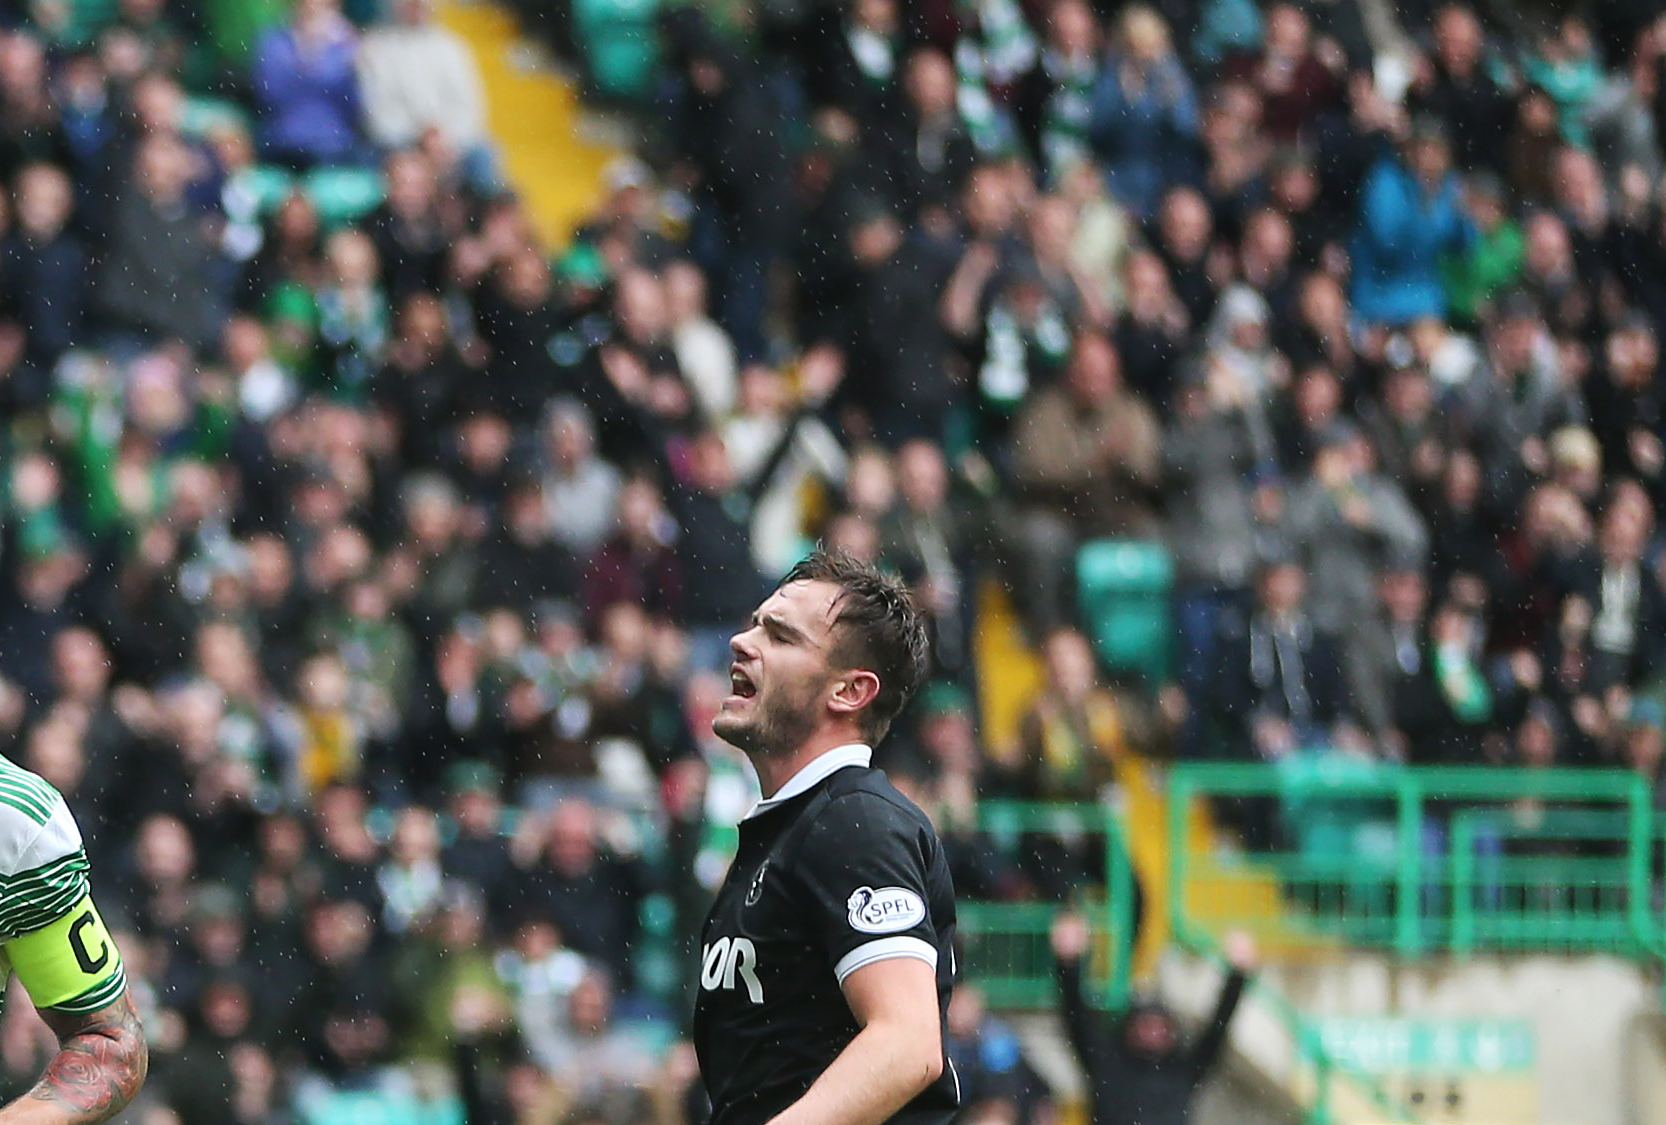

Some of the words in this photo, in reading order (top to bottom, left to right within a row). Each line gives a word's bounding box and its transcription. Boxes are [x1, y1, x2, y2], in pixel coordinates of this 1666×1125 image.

[870, 898, 915, 917] SPFL
[68, 910, 109, 974] C
[701, 936, 764, 1003] OR
